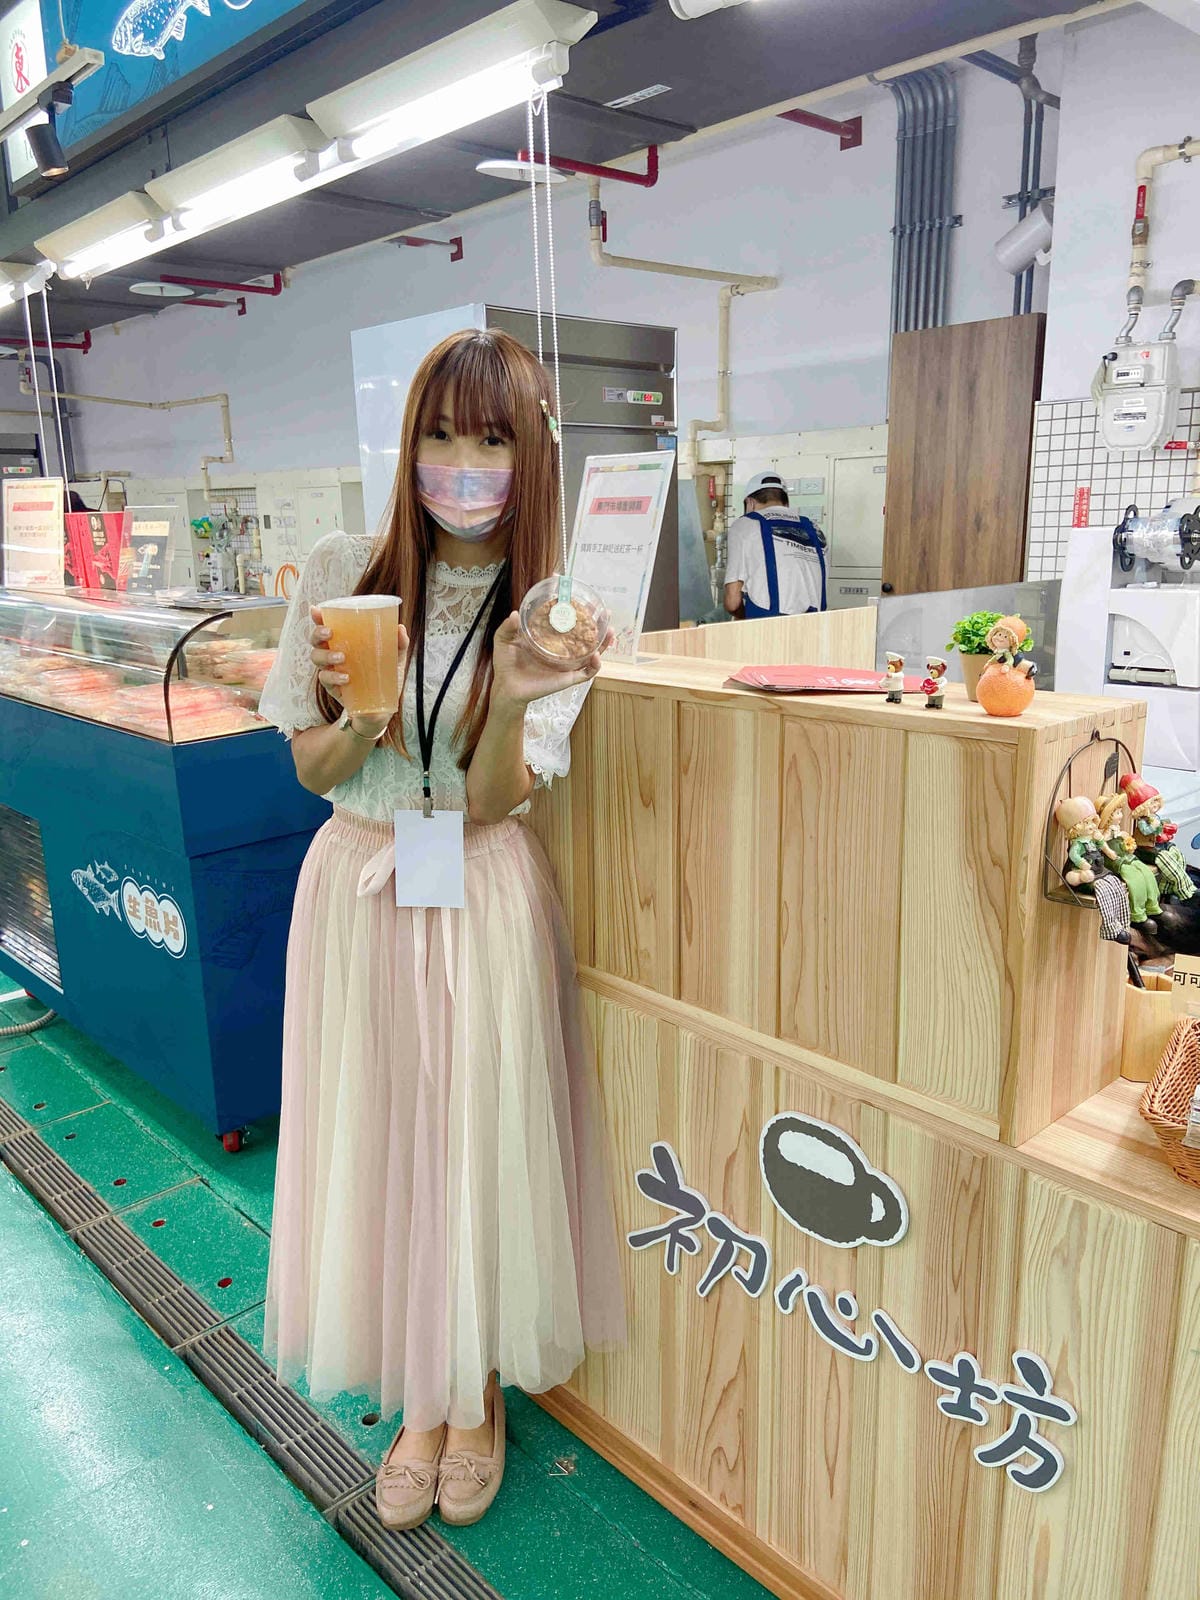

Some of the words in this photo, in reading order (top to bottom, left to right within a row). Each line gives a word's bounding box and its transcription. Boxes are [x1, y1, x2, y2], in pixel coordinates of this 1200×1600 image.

[127, 894, 181, 942] 生魚片
[628, 1141, 1078, 1492] 初心坊
